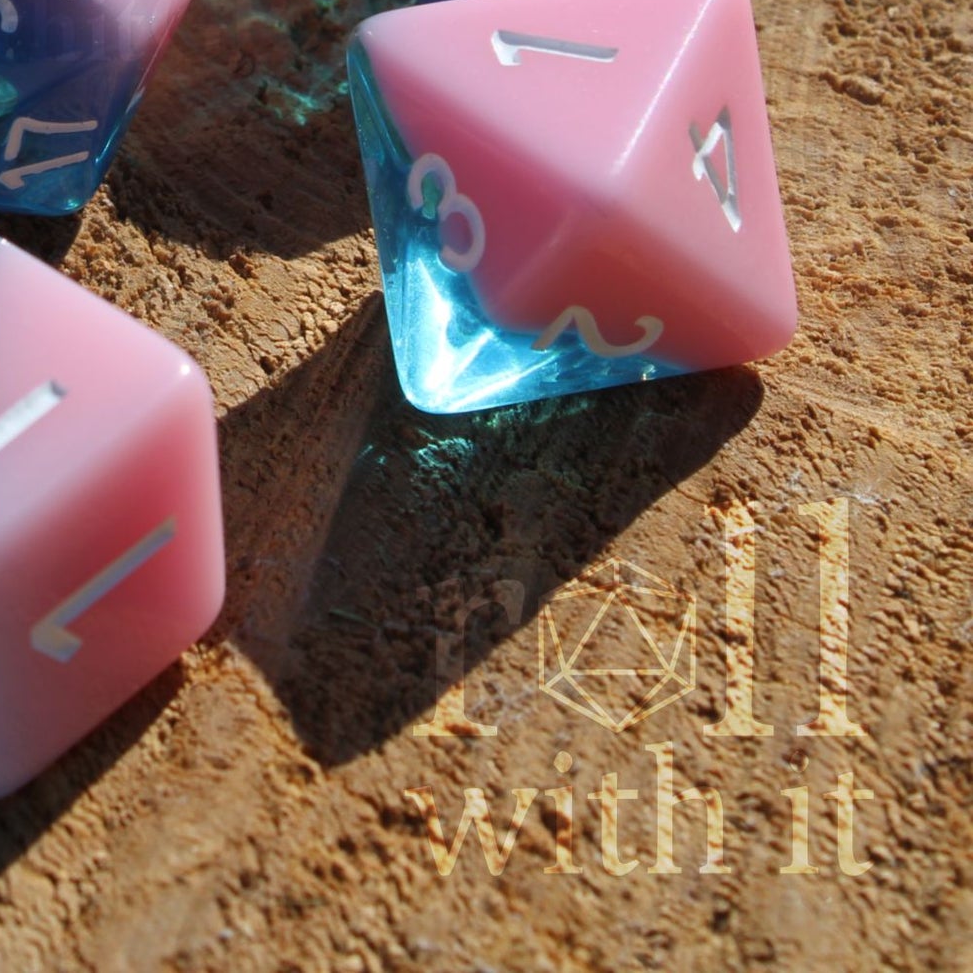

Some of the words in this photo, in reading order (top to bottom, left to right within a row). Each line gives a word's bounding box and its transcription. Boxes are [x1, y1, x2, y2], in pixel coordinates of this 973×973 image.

[491, 29, 619, 66] 1
[687, 105, 743, 234] 4
[533, 305, 665, 359] 2
[30, 517, 177, 664] 1
